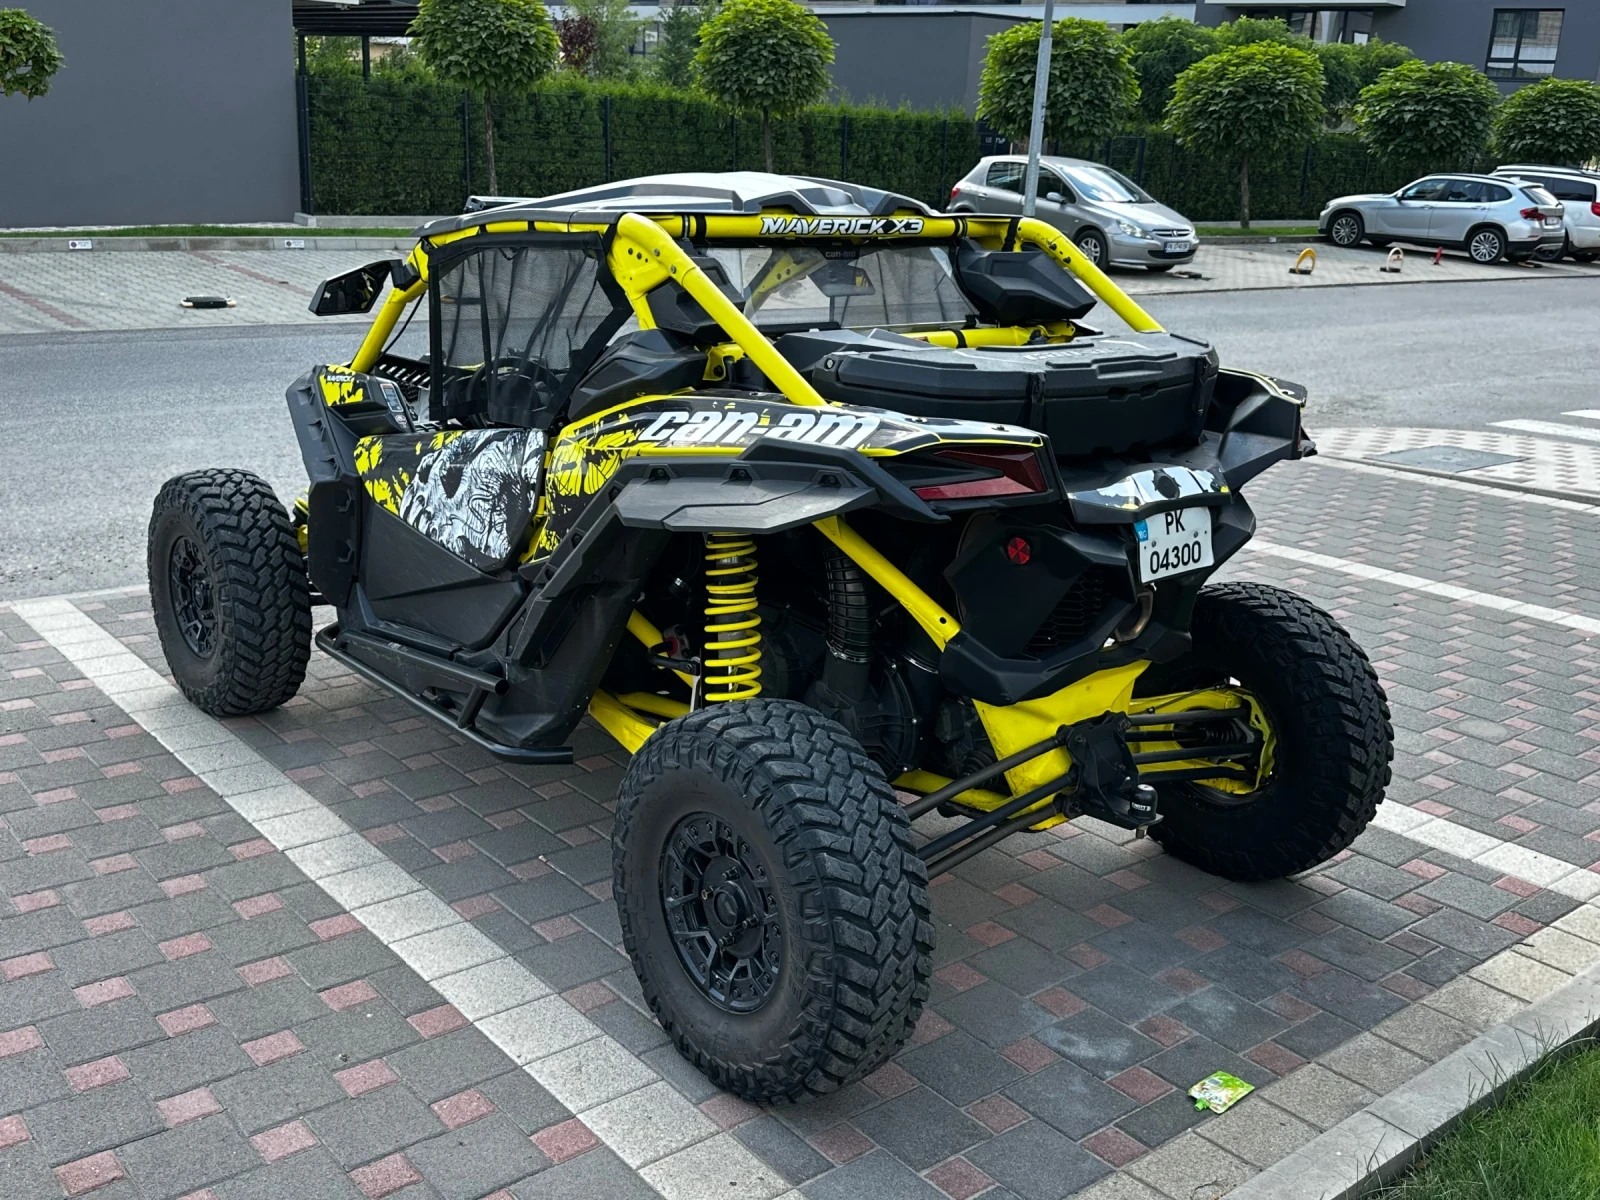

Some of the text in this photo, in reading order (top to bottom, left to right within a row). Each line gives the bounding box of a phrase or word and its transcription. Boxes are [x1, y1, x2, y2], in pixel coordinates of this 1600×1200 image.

[760, 217, 924, 235] MAVERICK X3
[638, 411, 881, 449] can-am
[1164, 508, 1186, 535] PK
[1149, 540, 1202, 574] 04300
